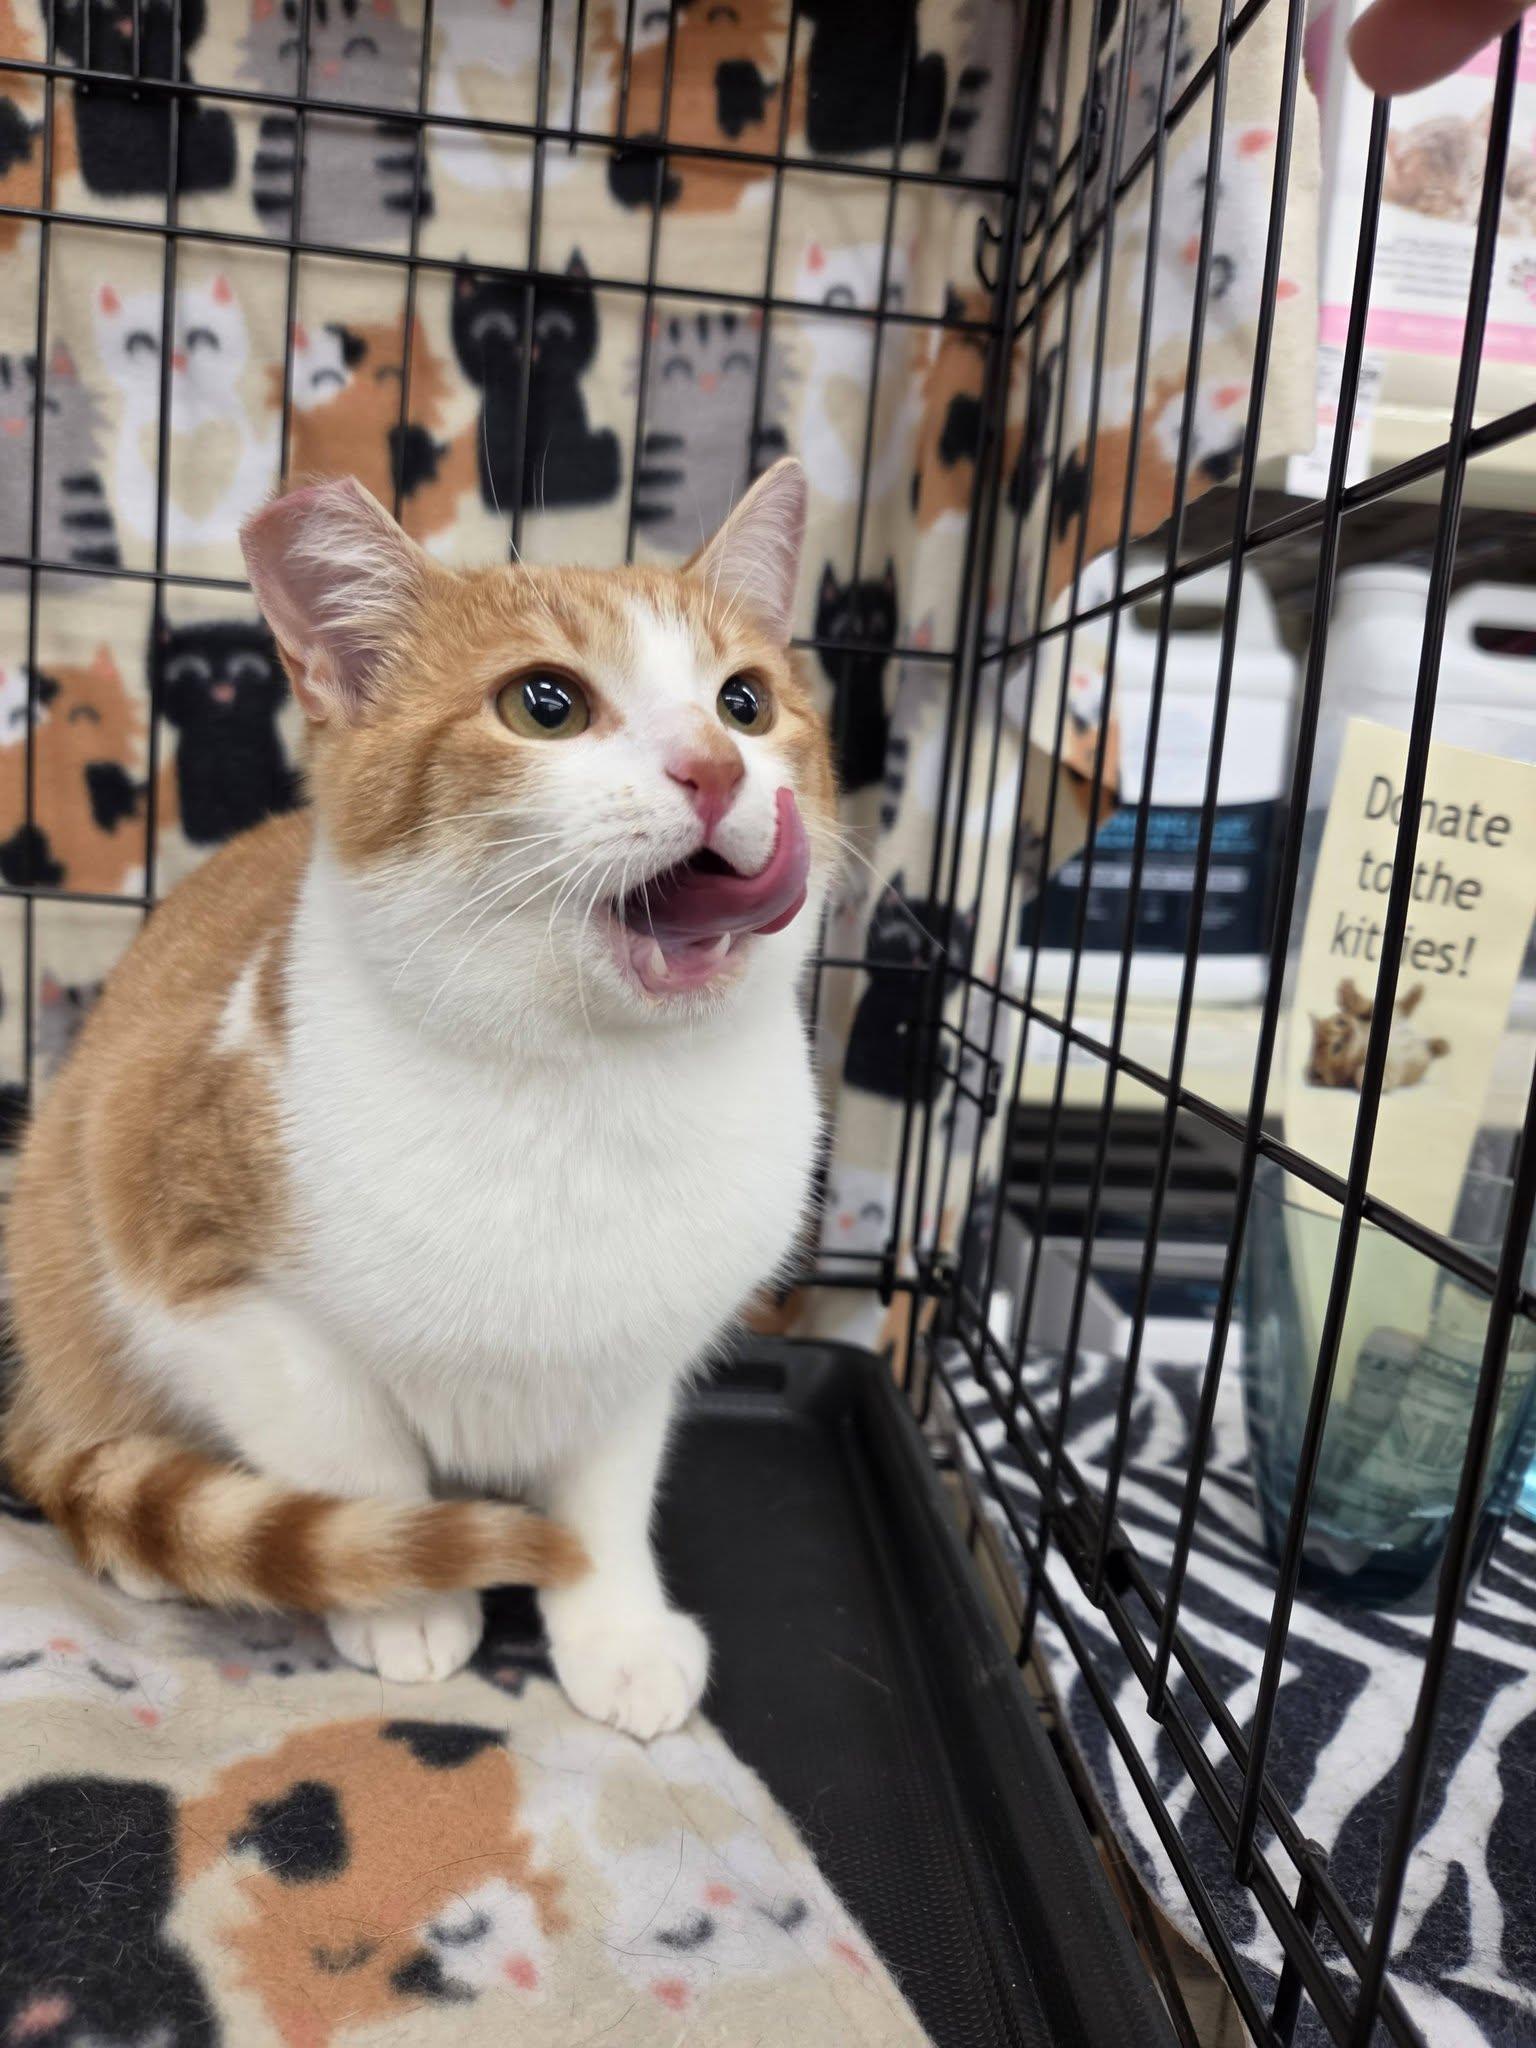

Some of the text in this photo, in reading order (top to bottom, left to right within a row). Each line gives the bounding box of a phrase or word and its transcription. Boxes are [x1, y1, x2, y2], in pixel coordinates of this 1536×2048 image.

[1358, 849, 1483, 910] to the
[1330, 911, 1476, 977] kities!
